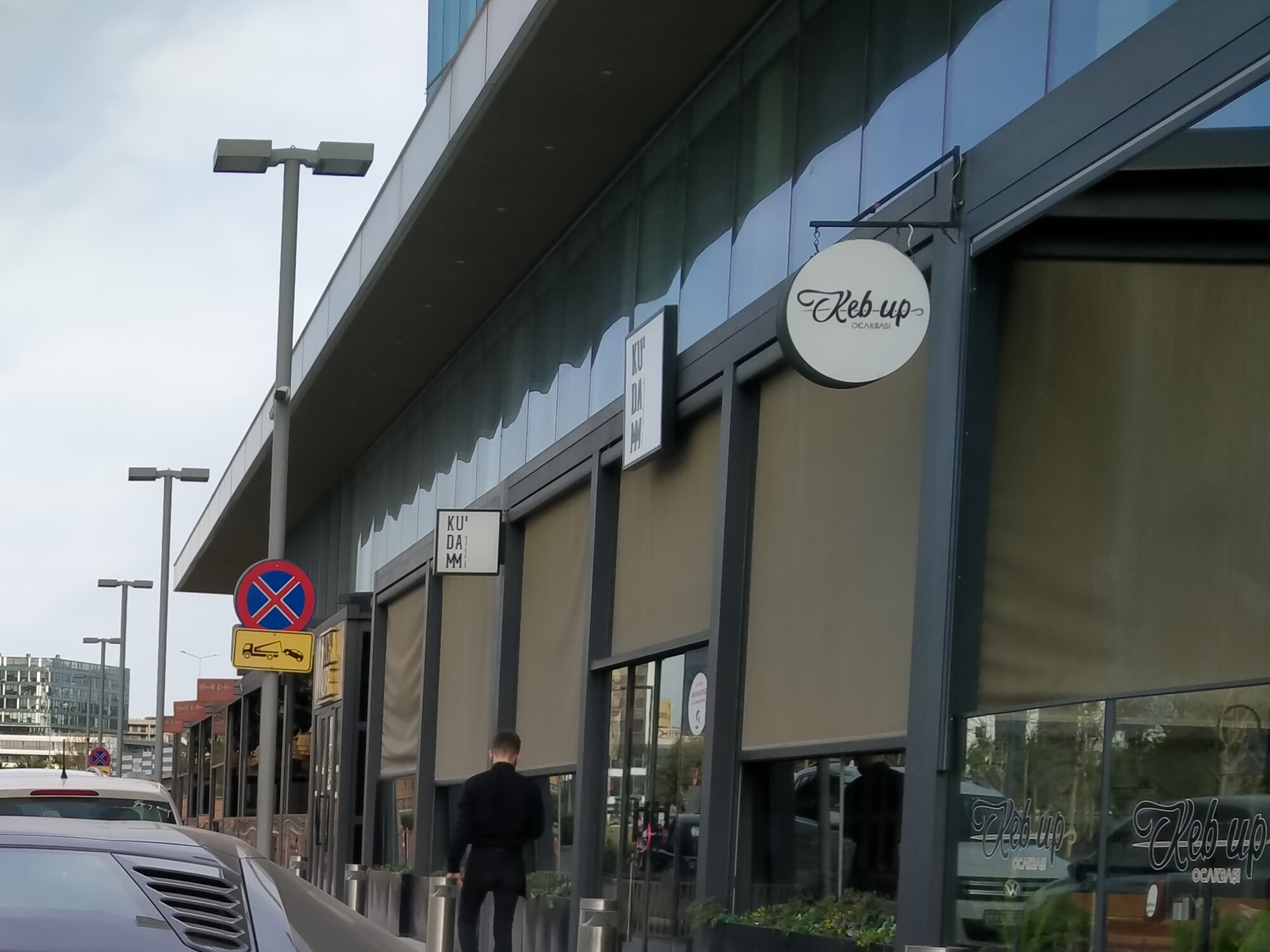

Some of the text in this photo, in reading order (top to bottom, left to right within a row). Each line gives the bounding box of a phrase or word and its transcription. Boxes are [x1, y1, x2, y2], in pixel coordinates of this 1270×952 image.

[797, 289, 911, 327] Keb up
[631, 378, 642, 415] DA
[446, 534, 463, 550] DA
[1132, 798, 1268, 879] Keb up
